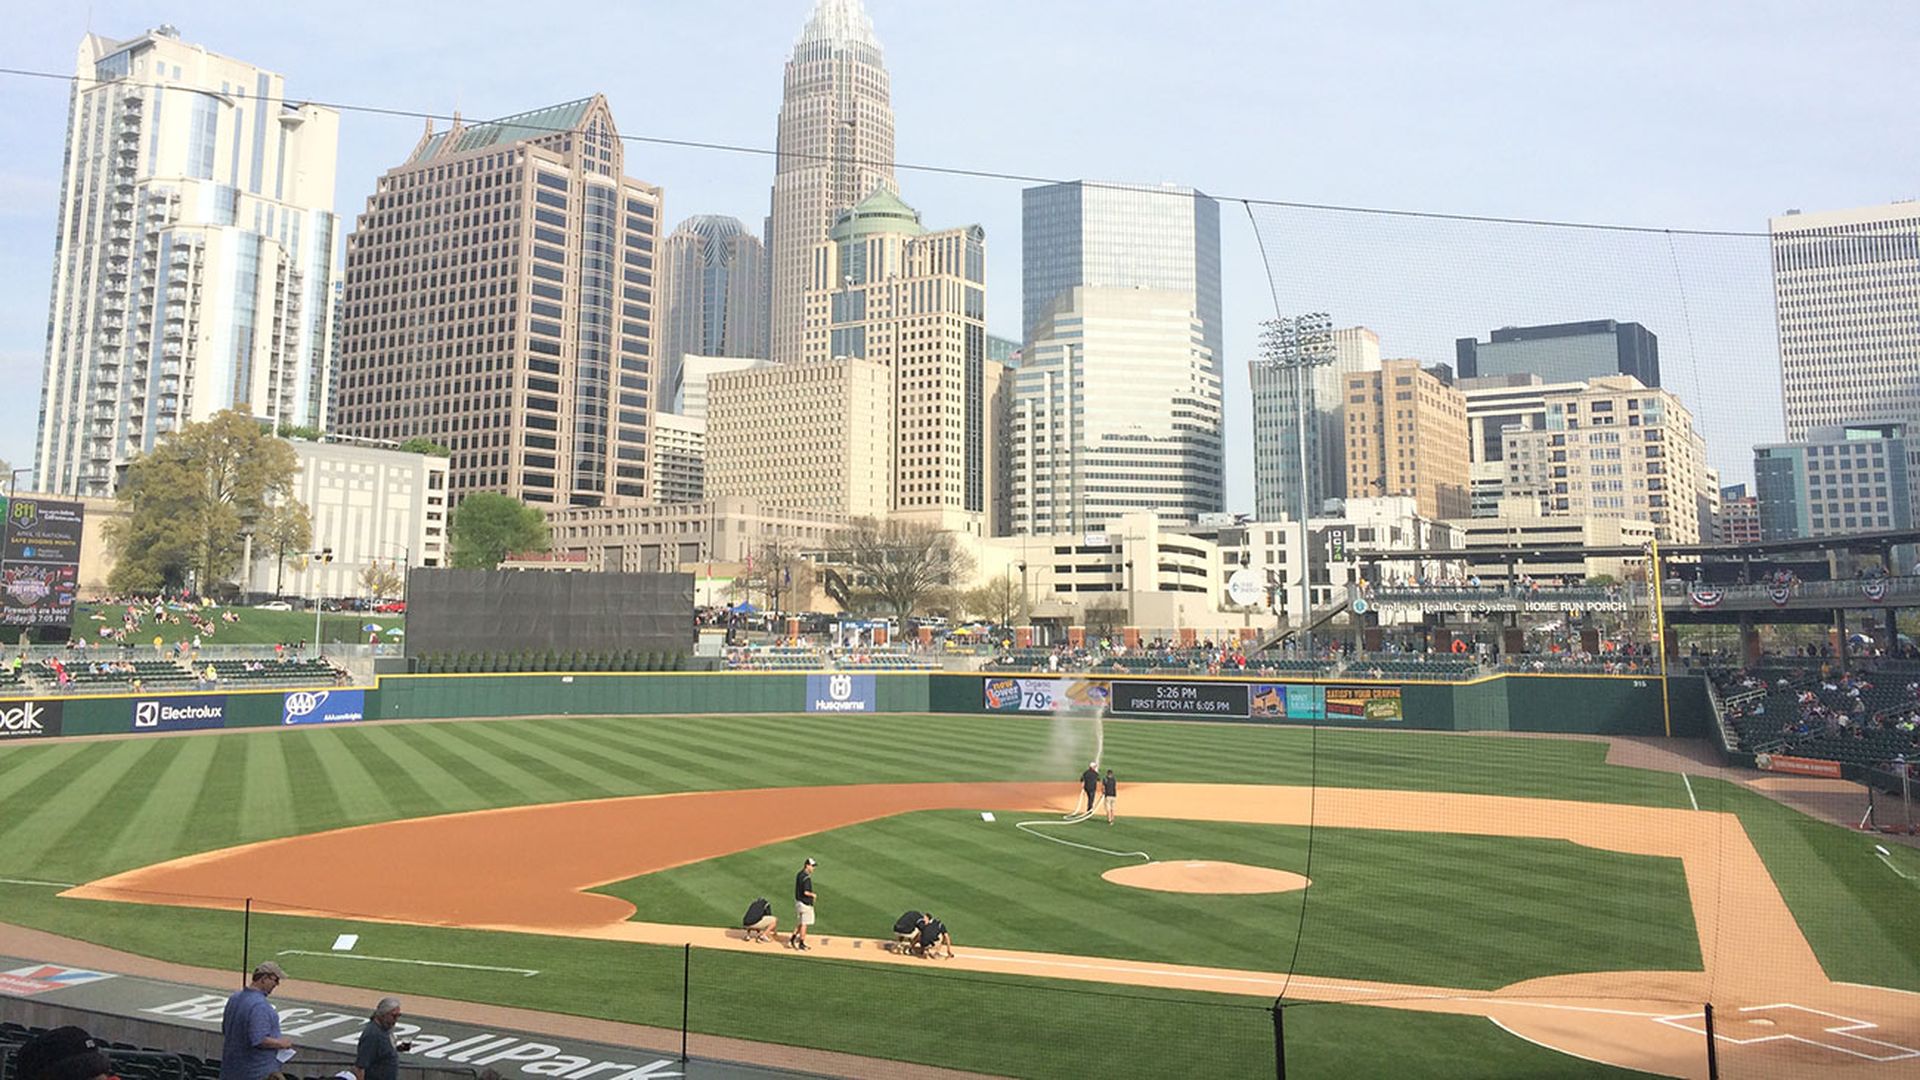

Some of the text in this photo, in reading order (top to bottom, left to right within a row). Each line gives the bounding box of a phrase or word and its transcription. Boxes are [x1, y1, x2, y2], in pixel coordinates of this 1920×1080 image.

[14, 503, 34, 518] 811
[1333, 530, 1342, 560] DC74
[4, 606, 37, 614] Fireworks
[52, 607, 69, 615] back!
[1371, 602, 1626, 613] Carolinas HealthCare System HOME RUN PORCH
[992, 680, 1014, 691] now
[1157, 687, 1197, 698] 5:26 PM
[287, 694, 314, 713] AAA
[816, 700, 865, 711] Husqvarna
[1131, 699, 1230, 711] FIRST PITCH AT 6:05 PM
[161, 704, 222, 720] Electrolux
